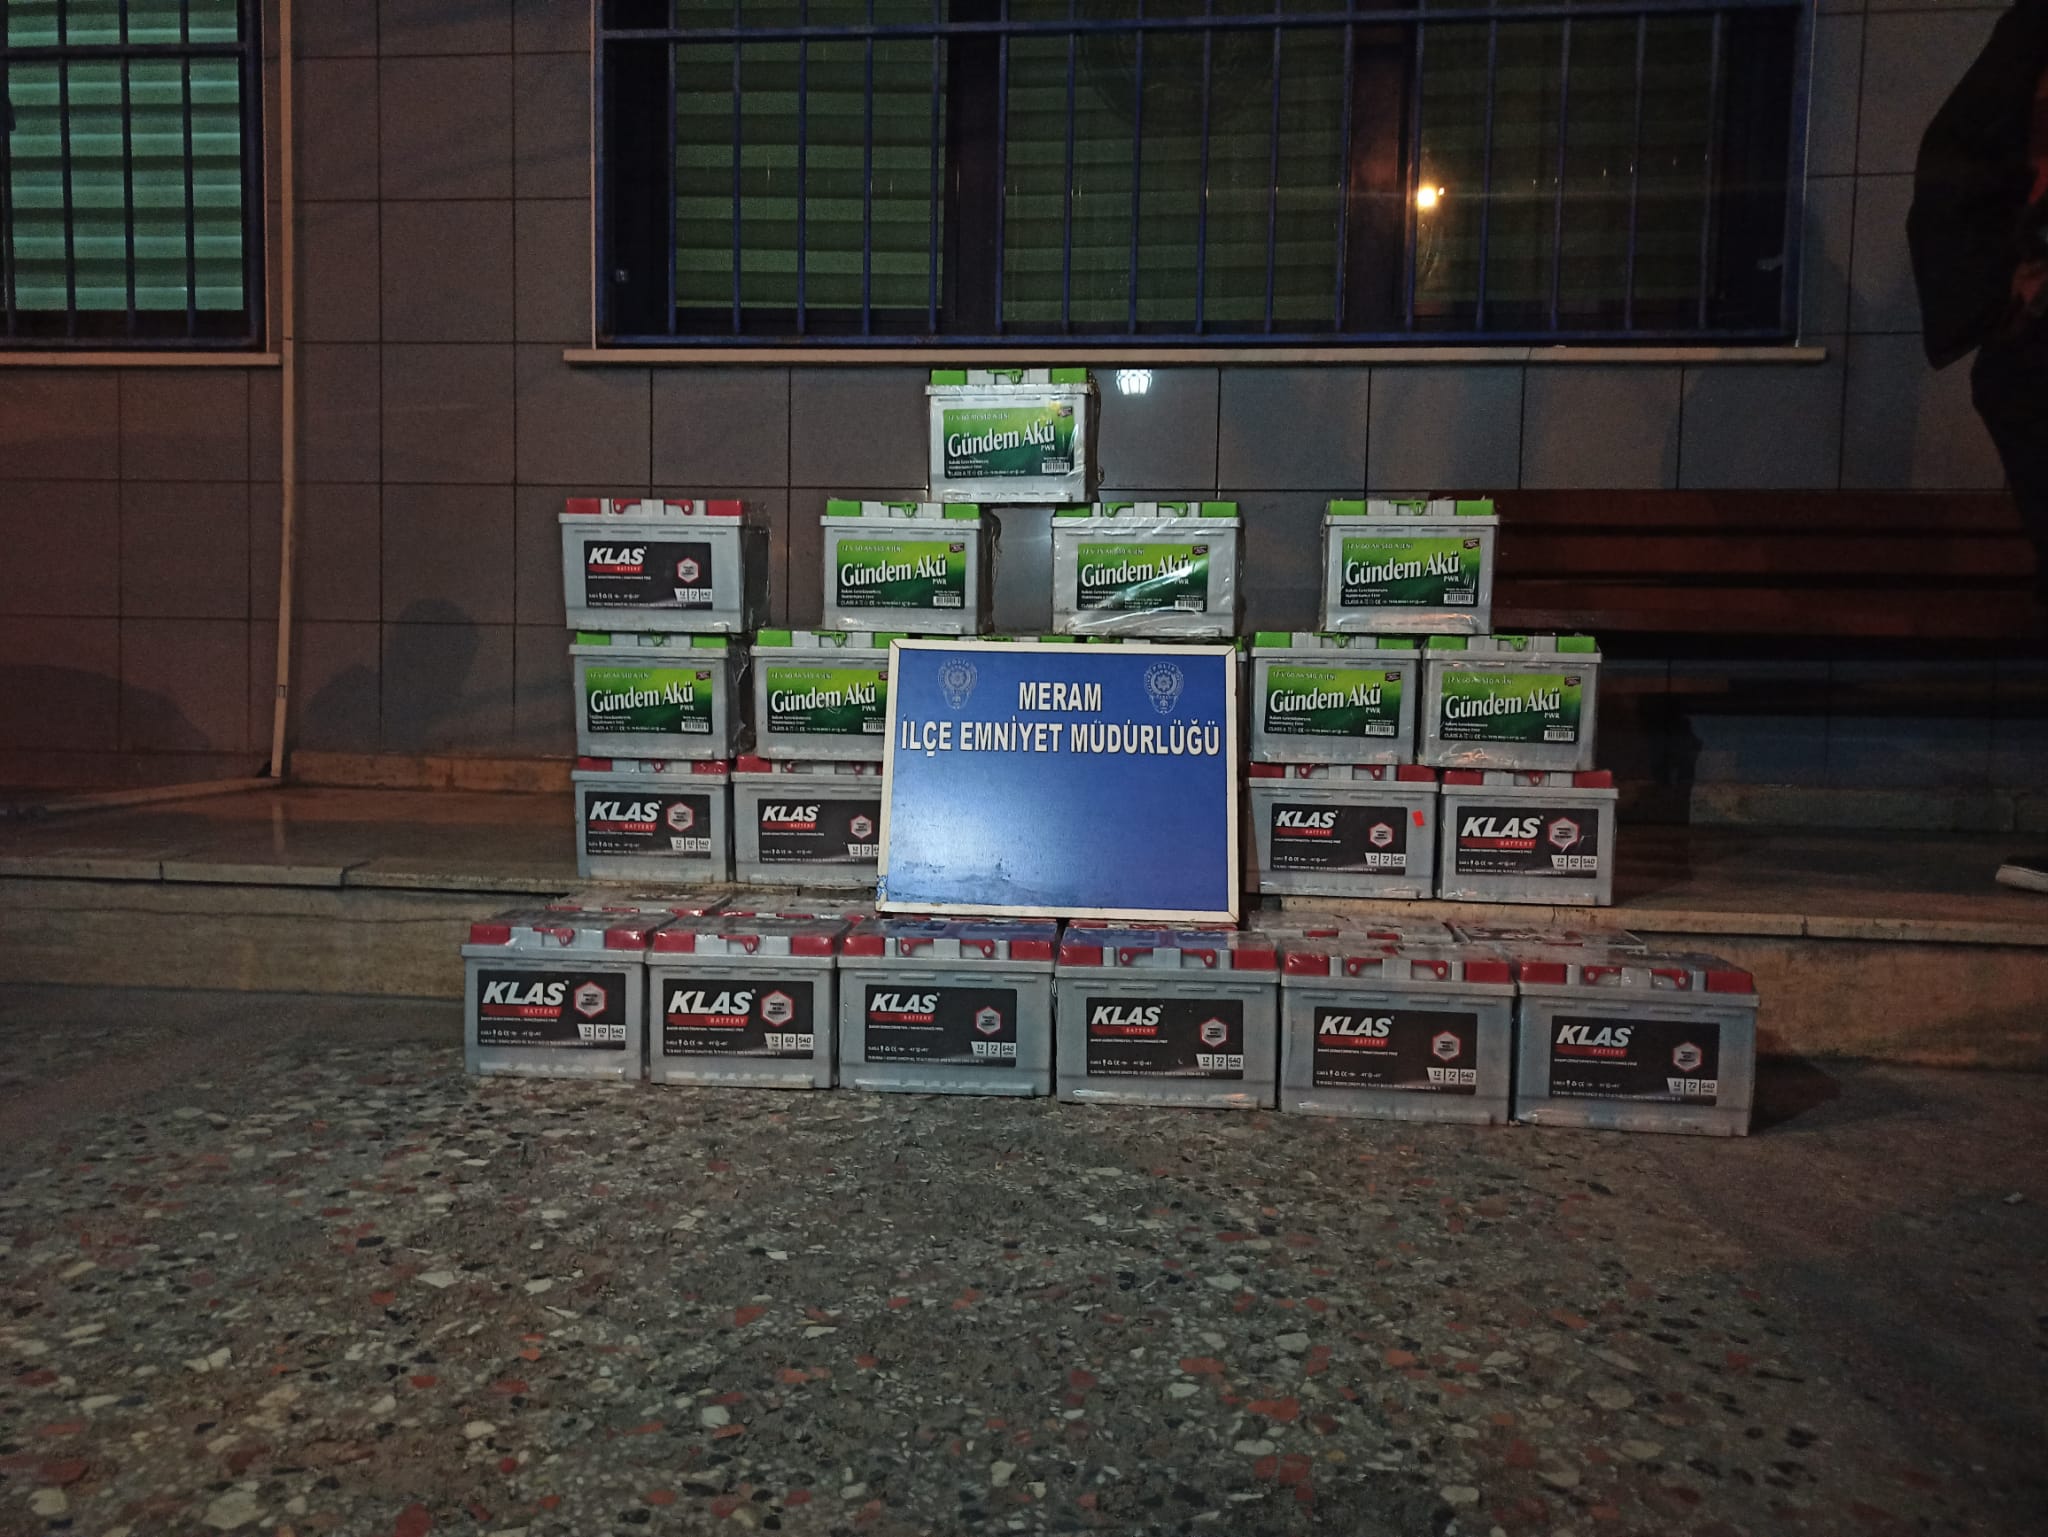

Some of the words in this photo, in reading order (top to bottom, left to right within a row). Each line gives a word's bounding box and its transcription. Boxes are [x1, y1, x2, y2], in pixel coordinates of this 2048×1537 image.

[948, 428, 1019, 457] Gündem
[1022, 420, 1055, 446] Akü
[589, 547, 645, 565] KLAS
[1345, 558, 1421, 585] Gündem
[1424, 552, 1459, 576] Akü
[841, 560, 911, 586] Gündem
[914, 554, 947, 579] Akü
[1081, 560, 1153, 587] Gündem
[591, 686, 659, 713] Gündem
[662, 681, 694, 705] Akü
[771, 687, 841, 713] Gündem
[843, 682, 875, 706] Akü
[1019, 682, 1102, 711] MERAM
[1270, 688, 1344, 713] Gündem
[1347, 683, 1381, 707] Akü
[1446, 692, 1521, 719] Gündem
[1525, 688, 1560, 713] Akü
[902, 713, 952, 757] İLÇE
[960, 715, 1063, 752] EMNİYET
[590, 801, 659, 822] KLAS
[762, 805, 818, 822] KLAS
[1276, 811, 1336, 829] KLAS
[1461, 817, 1541, 838] KLAS
[483, 981, 566, 1005] KLAS
[668, 990, 752, 1015] KLAS
[870, 993, 938, 1013] KLAS
[1092, 1006, 1161, 1026] KLAS
[1320, 1016, 1392, 1037] KLAS
[1556, 1025, 1632, 1047] KLAS
